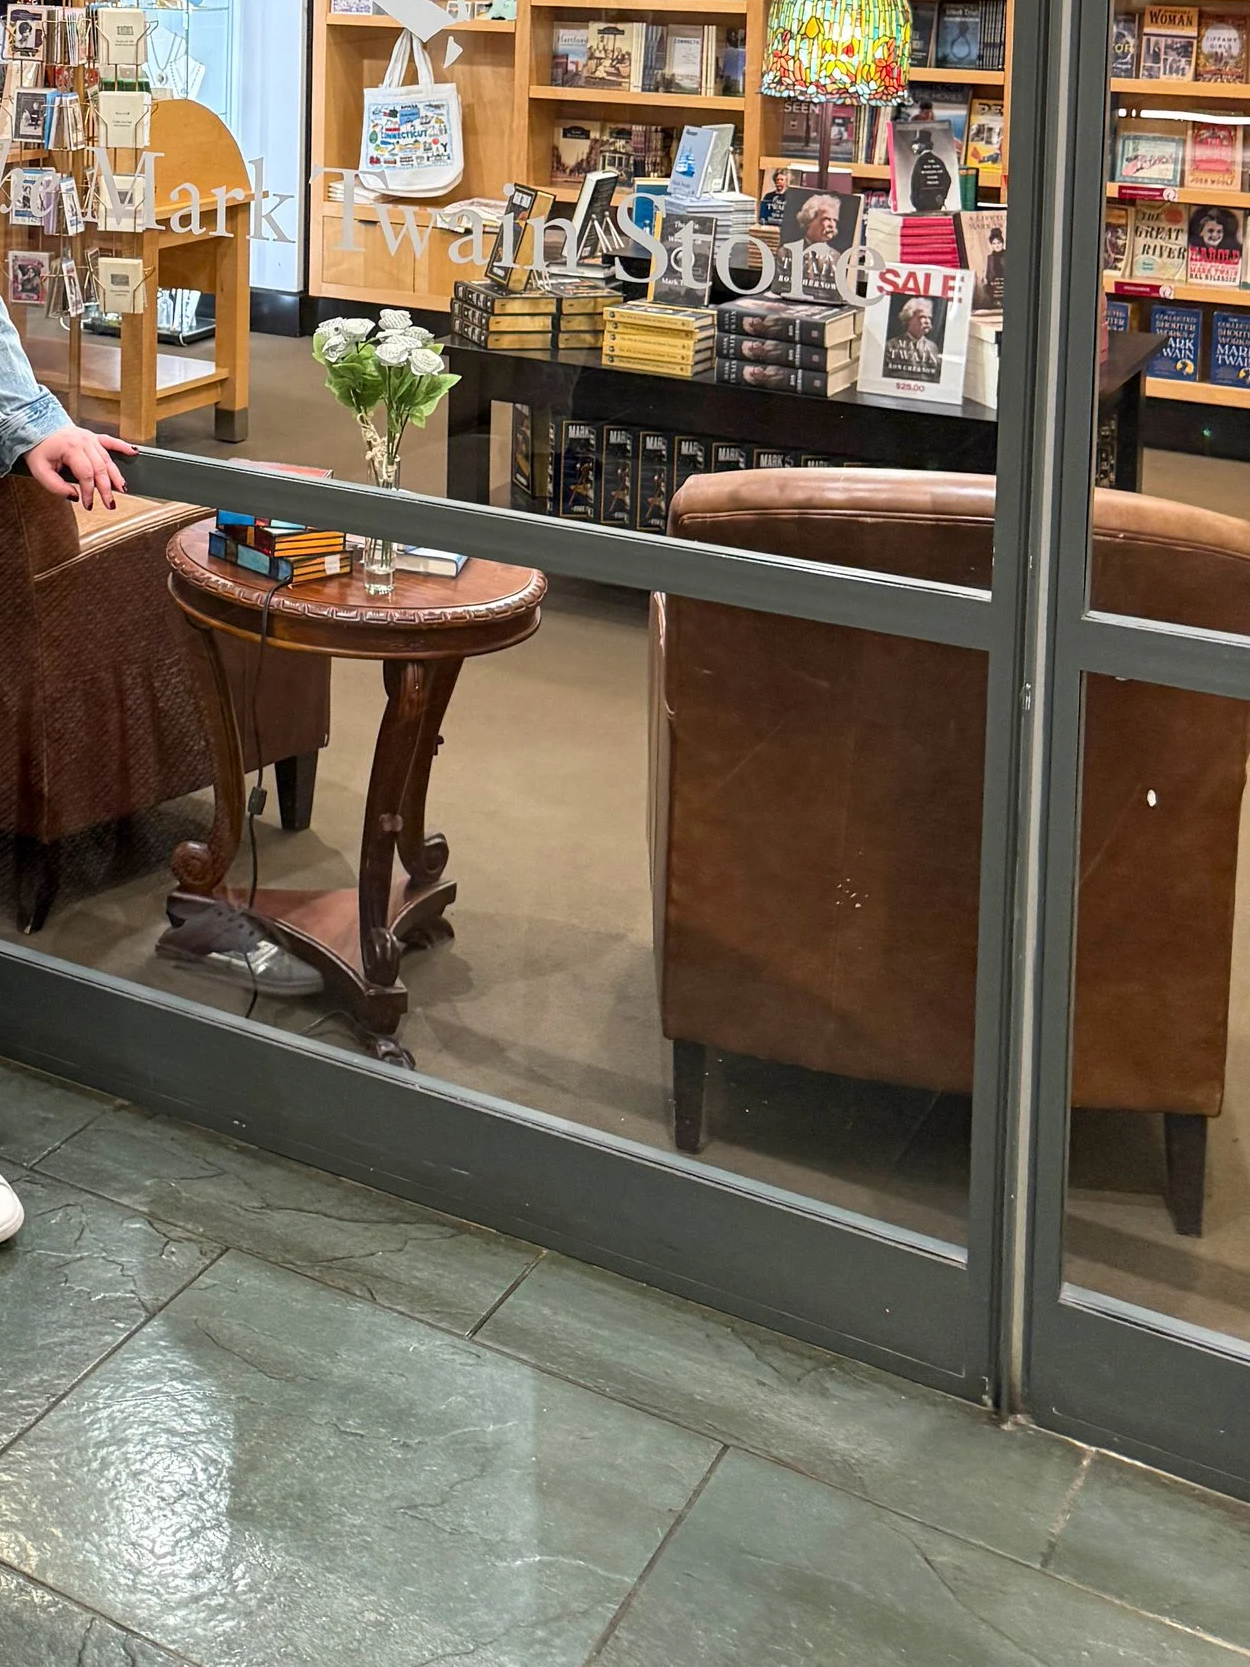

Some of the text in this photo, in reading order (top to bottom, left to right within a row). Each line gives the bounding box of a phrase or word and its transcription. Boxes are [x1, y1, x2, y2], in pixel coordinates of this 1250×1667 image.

[1149, 8, 1194, 27] WOMAN
[783, 102, 820, 114] SEEN
[81, 146, 297, 244] Mark
[308, 166, 580, 274] Twain
[614, 193, 887, 308] Store
[1135, 225, 1184, 242] GREAT
[1141, 243, 1187, 261] RIVER
[661, 277, 679, 286] Mark
[802, 278, 838, 290] HERNOW
[877, 268, 963, 304] SALE
[898, 339, 932, 352] MARK
[1167, 336, 1195, 350] ARK
[888, 347, 939, 364] TWAIN
[1162, 346, 1195, 360] WAIN
[759, 453, 785, 468] MARK
